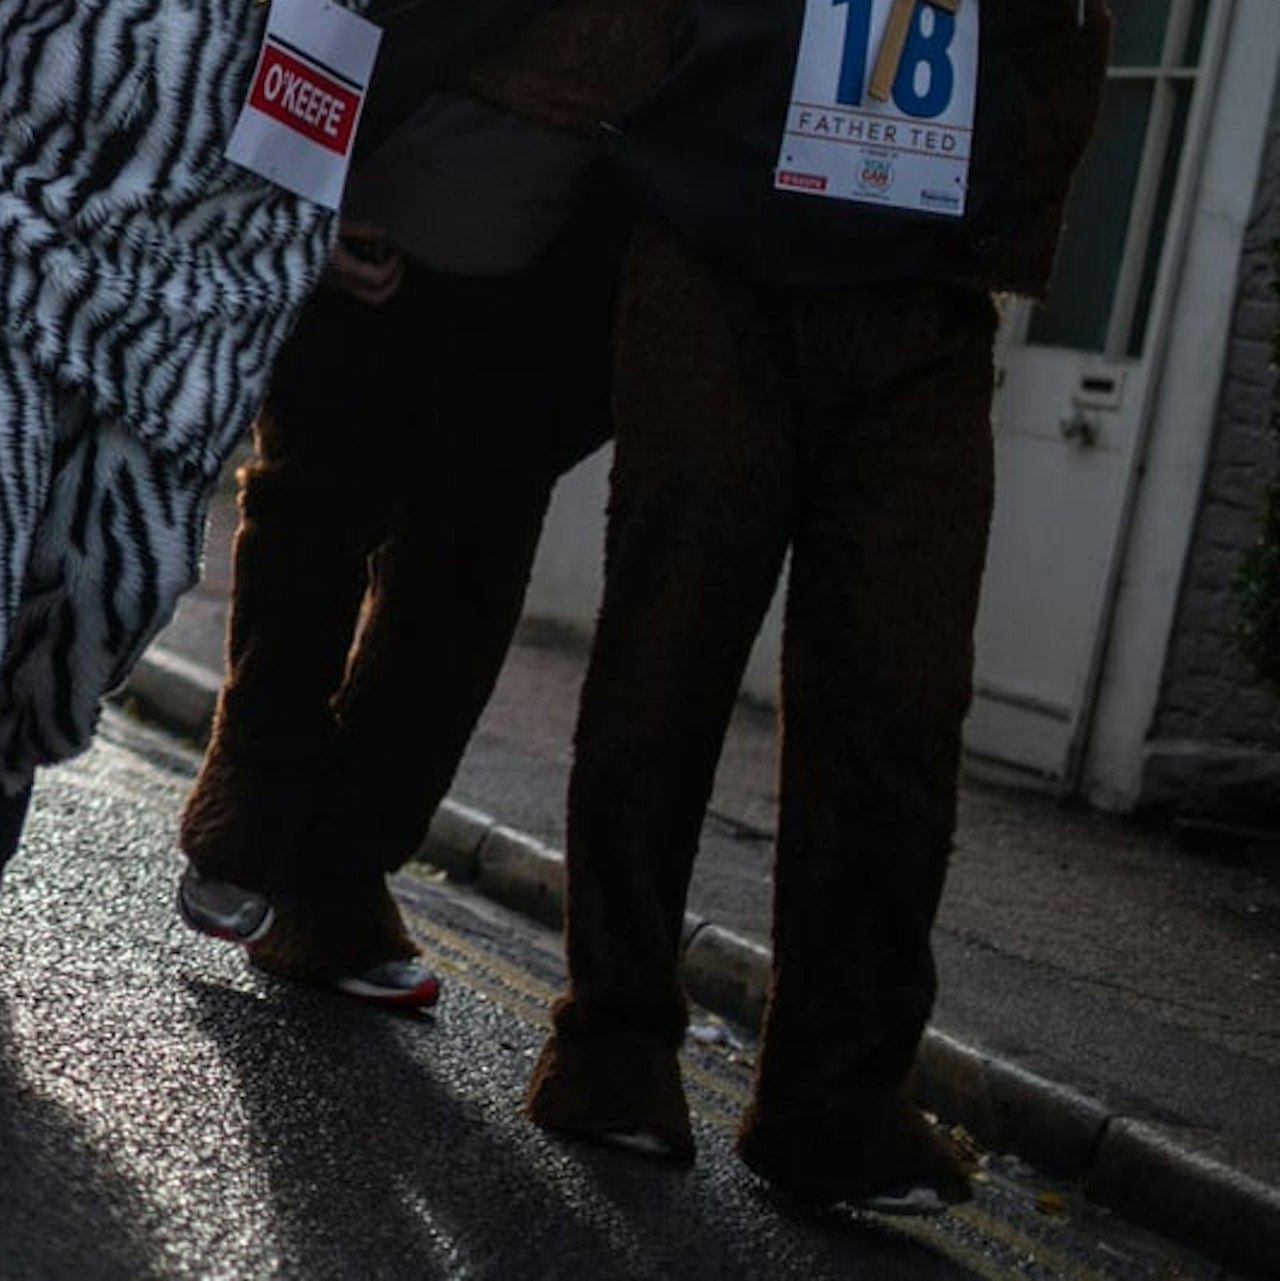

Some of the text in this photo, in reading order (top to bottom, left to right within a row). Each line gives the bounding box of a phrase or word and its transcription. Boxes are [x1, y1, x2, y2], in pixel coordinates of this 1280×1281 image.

[262, 62, 346, 138] O'KEEFE
[798, 112, 957, 152] FATHER TED
